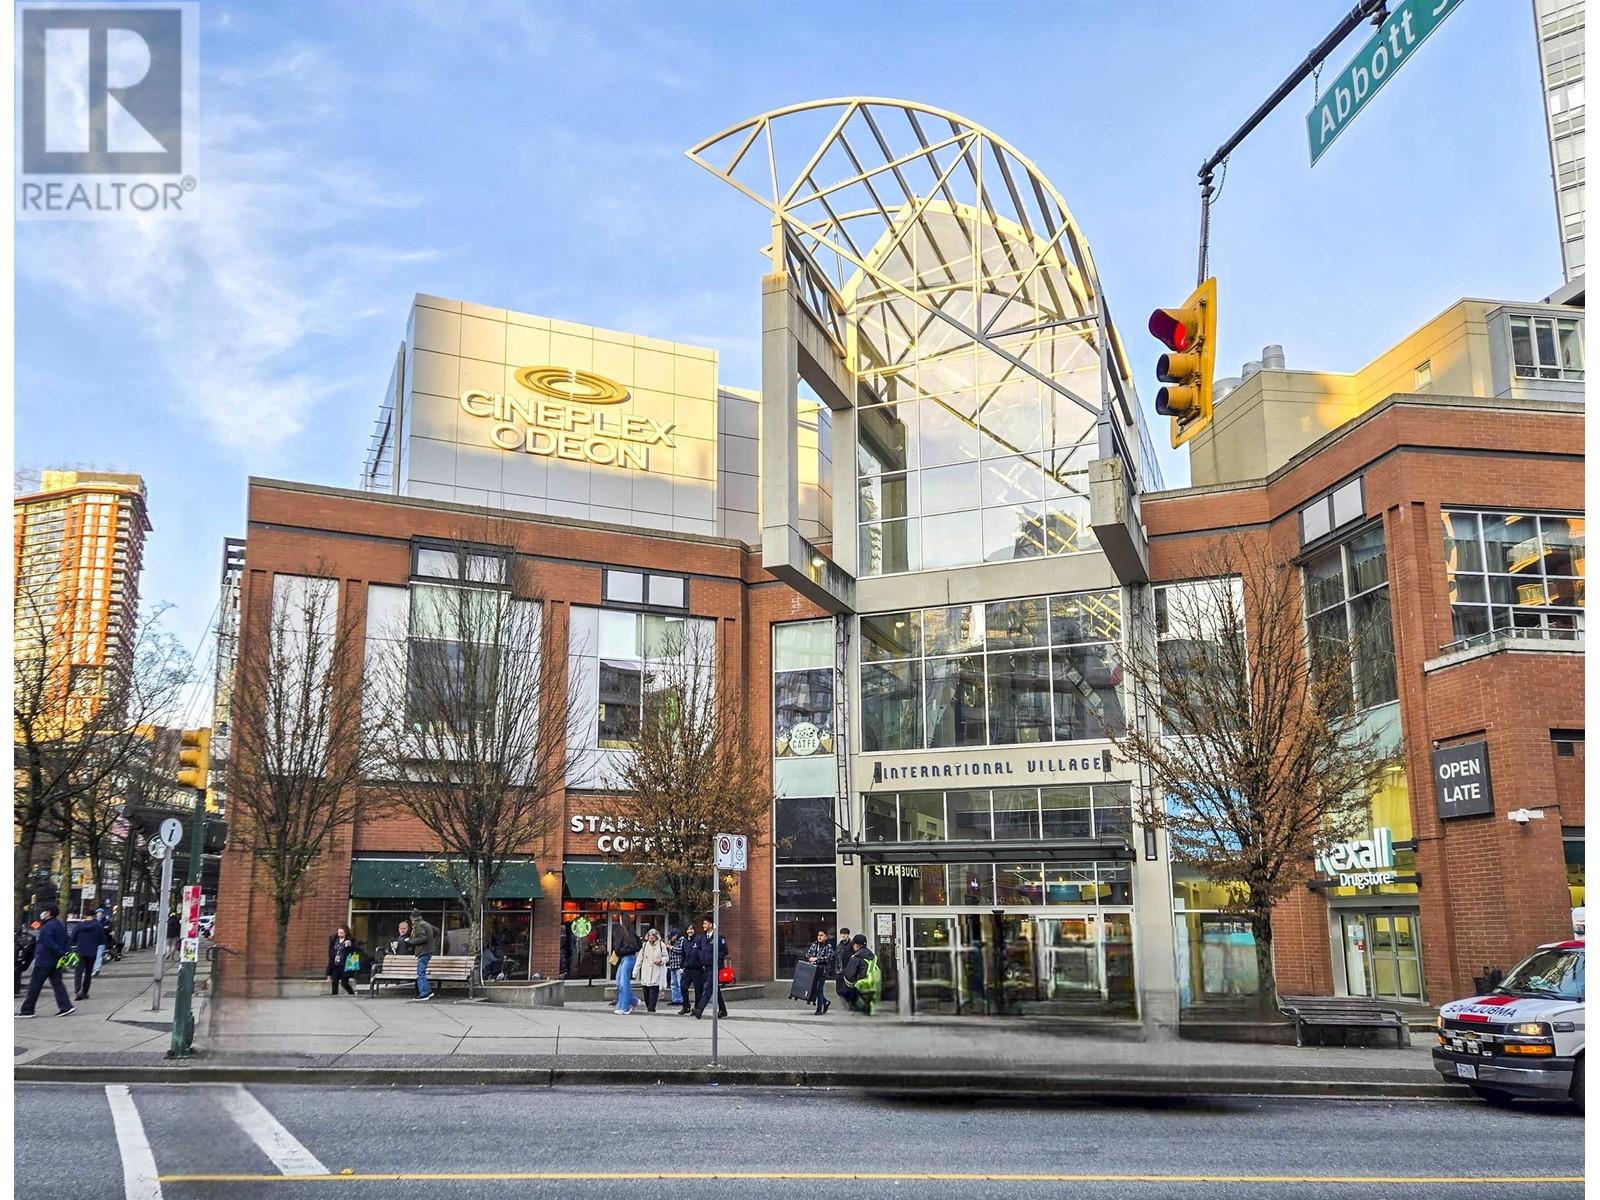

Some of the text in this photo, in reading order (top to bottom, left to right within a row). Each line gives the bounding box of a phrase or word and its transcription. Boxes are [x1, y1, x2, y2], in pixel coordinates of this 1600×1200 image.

[1319, 9, 1416, 144] Abbott
[460, 389, 677, 448] CINEPLEX
[489, 422, 650, 471] ODEON
[792, 740, 816, 748] CATFE
[883, 757, 1102, 780] INTERNATIONAL VILLAGE
[1439, 758, 1481, 779] OPEN
[1443, 783, 1481, 803] LATE
[1340, 872, 1389, 889] Drugstore
